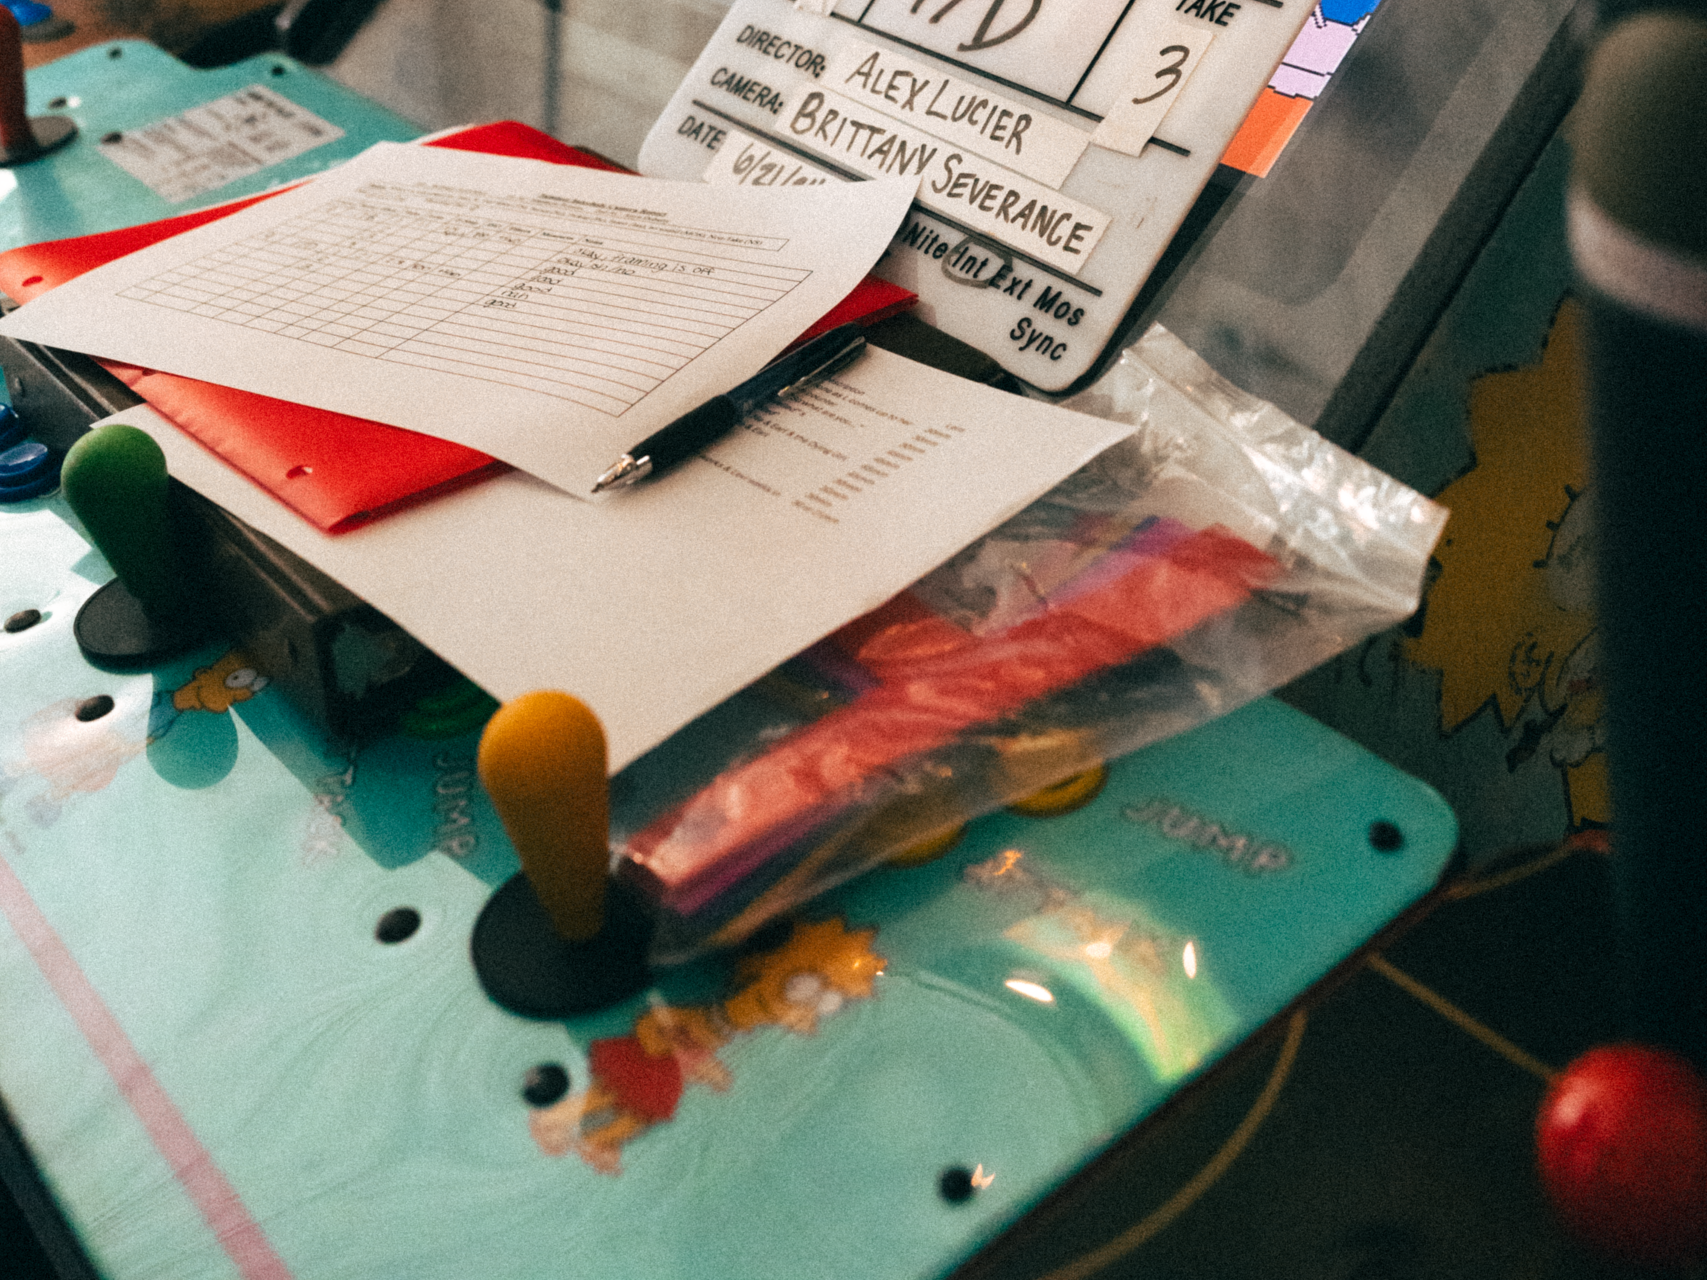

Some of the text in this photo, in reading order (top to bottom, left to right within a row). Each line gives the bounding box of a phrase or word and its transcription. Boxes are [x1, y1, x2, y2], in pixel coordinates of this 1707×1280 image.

[736, 24, 827, 79] DIRECTOR:
[1131, 44, 1190, 105] 3
[710, 67, 784, 115] CAMERA:
[845, 51, 1033, 156] ALEX LUCIER
[677, 115, 728, 151] DATE
[789, 91, 1094, 255] BRITTANY SEVERANCE
[902, 222, 949, 260] Nite
[952, 246, 990, 279] Int
[988, 263, 1034, 301] Ext
[1033, 286, 1086, 327] Mos
[1009, 316, 1068, 362] Sync
